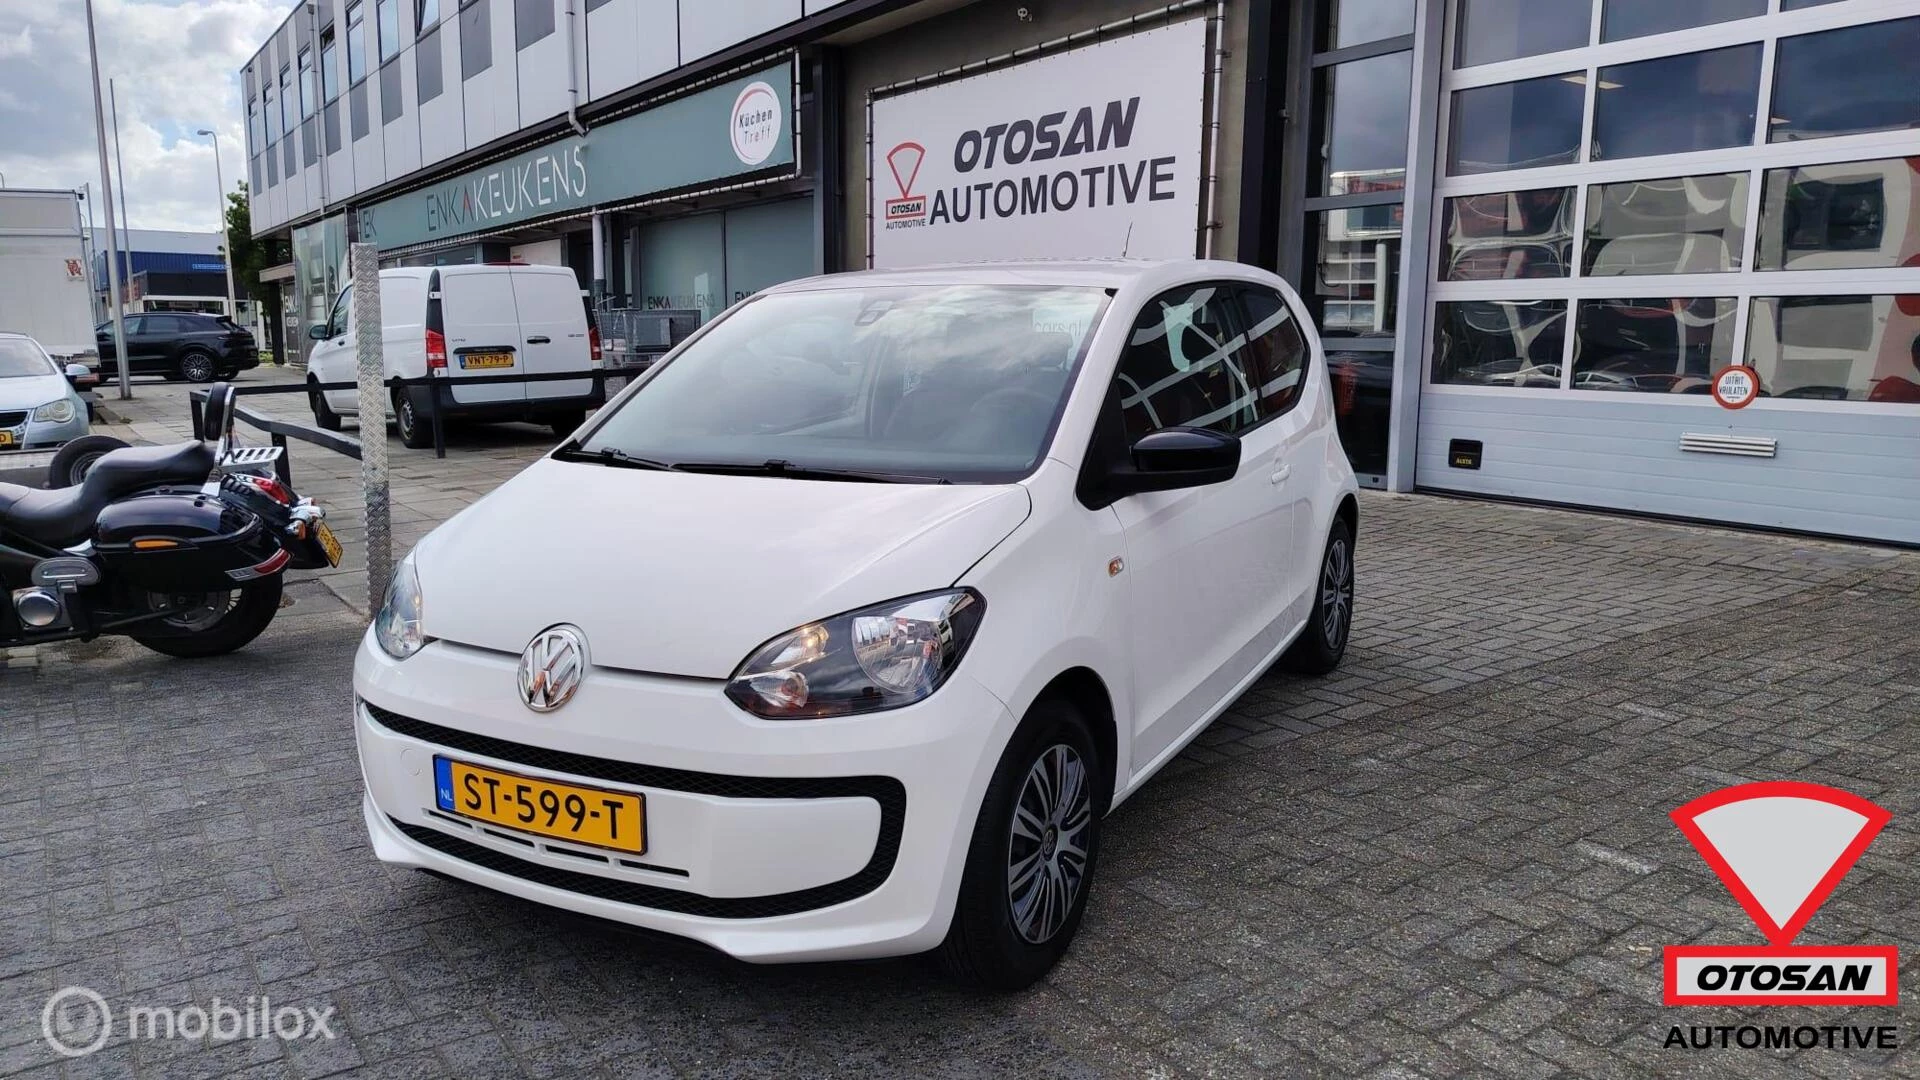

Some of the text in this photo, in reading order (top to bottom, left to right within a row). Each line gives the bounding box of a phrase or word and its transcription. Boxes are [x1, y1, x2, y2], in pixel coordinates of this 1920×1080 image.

[739, 109, 773, 128] Küchen
[744, 125, 771, 144] Treff
[953, 96, 1141, 173] OTOSAN
[929, 156, 1176, 225] AUTOMOTIVE
[891, 202, 922, 214] OTOSAN
[886, 219, 926, 230] AUTOMOTIVE
[1725, 376, 1744, 385] UITRIT
[440, 773, 624, 839] NL ST-599-T
